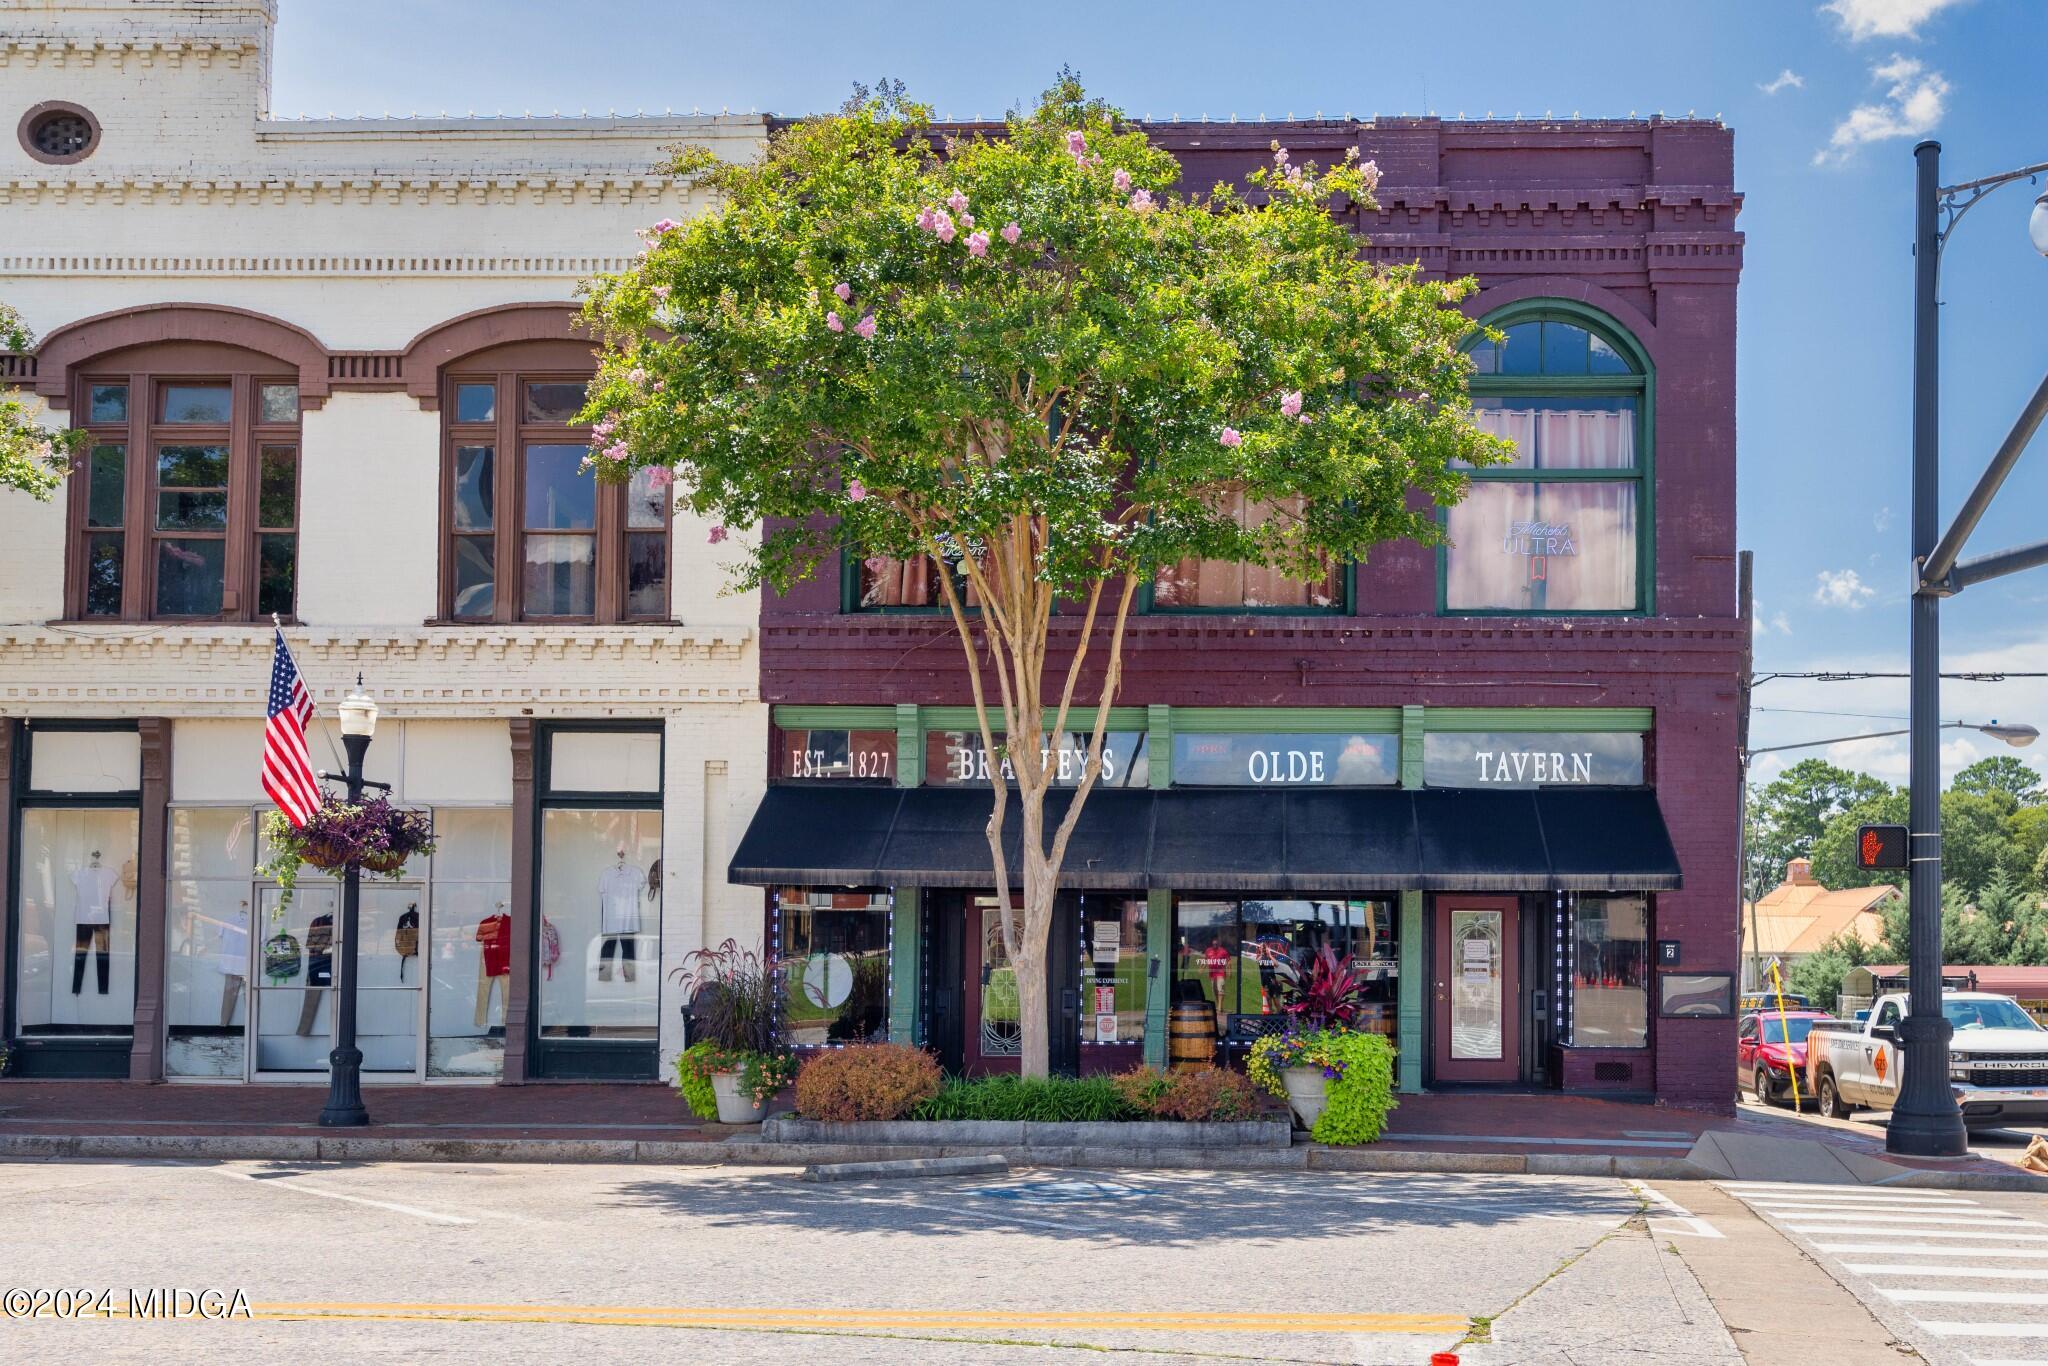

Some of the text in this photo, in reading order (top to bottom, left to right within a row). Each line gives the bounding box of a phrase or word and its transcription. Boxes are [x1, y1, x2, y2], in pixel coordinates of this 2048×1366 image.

[1503, 537, 1576, 555] ULTRA
[792, 749, 831, 778] EST.
[848, 751, 889, 777] 1827
[958, 748, 1593, 783] BRALEYS OLDE TAVERN
